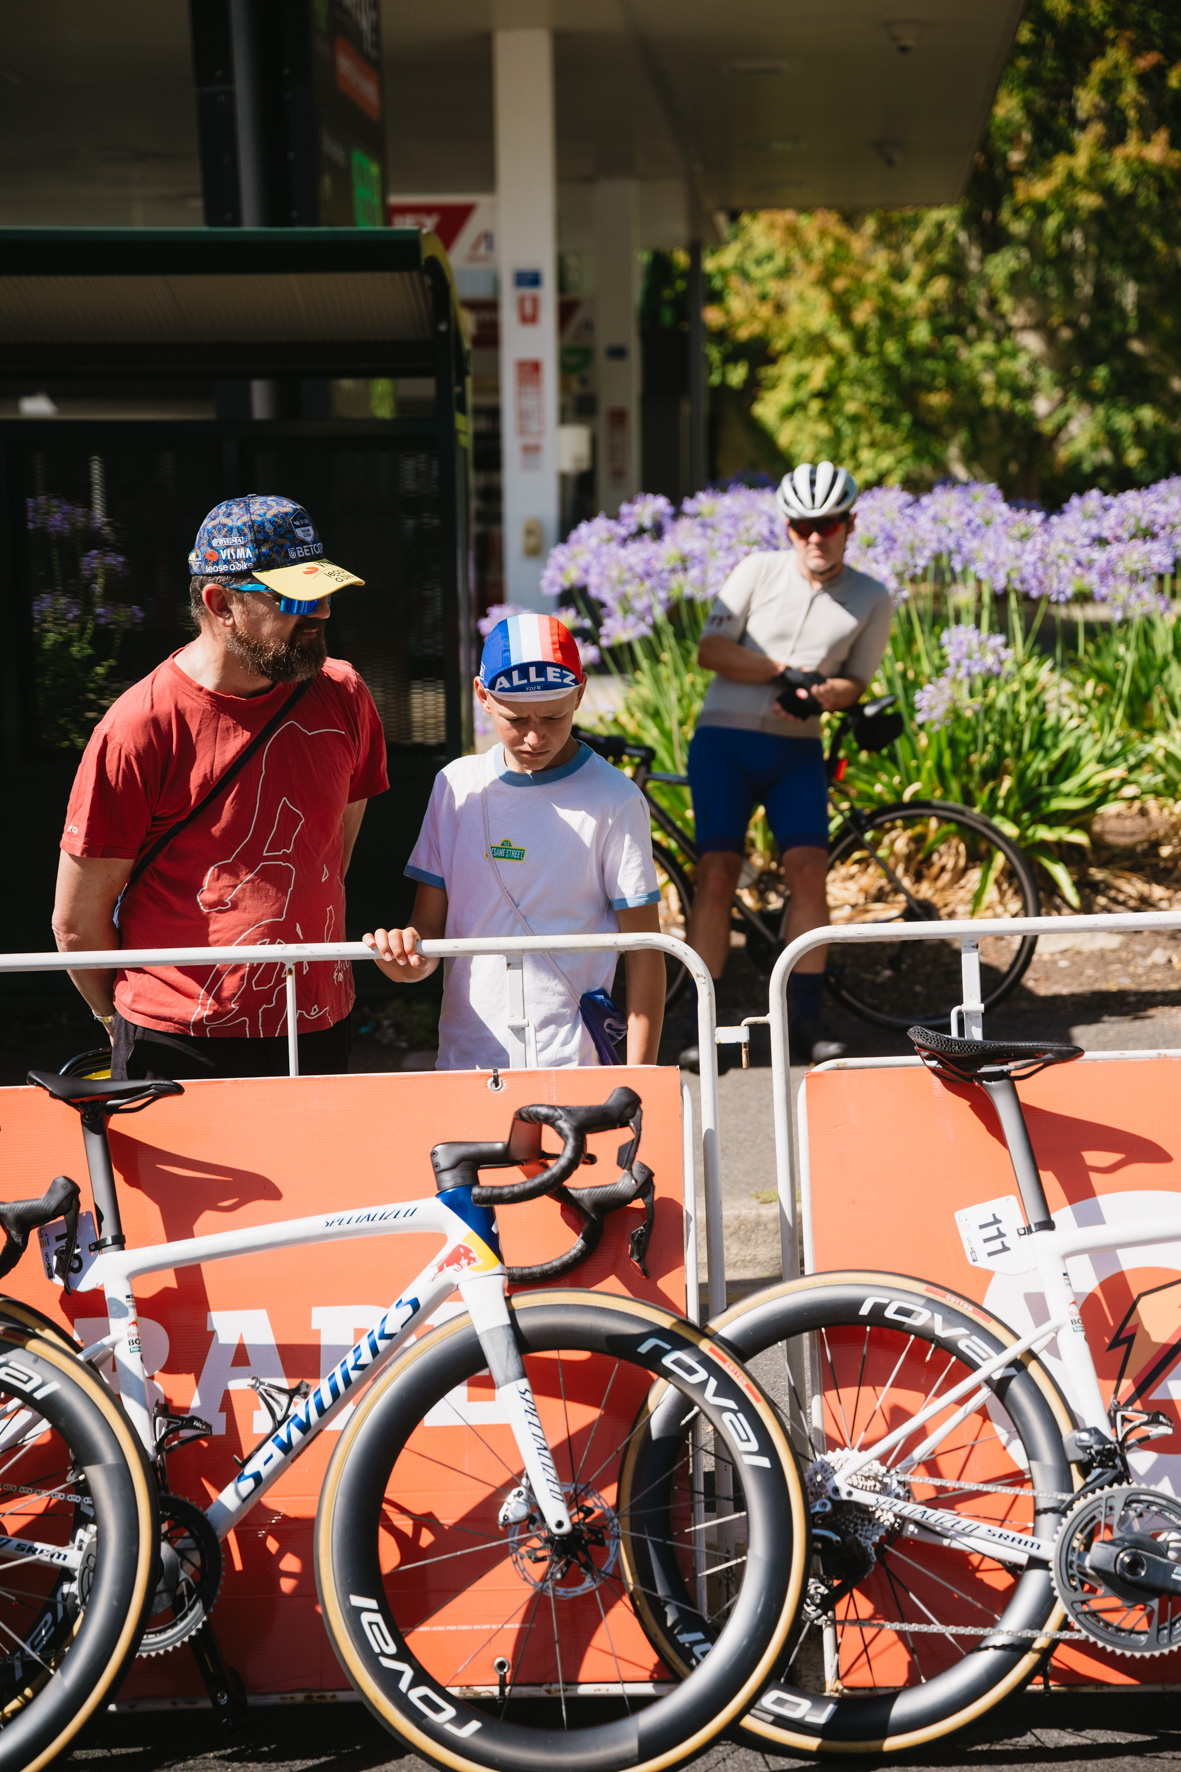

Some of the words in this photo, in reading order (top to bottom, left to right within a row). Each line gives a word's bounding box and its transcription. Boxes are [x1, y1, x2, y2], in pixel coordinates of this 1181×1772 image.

[220, 547, 253, 560] VISMA
[205, 564, 228, 573] lease
[495, 666, 576, 691] ALLEZ
[506, 849, 524, 859] STREET
[322, 1206, 418, 1228] SPECIALIZED
[978, 1213, 1011, 1257] 111
[945, 1294, 974, 1312] COTTON
[0, 1356, 61, 1400] al
[725, 1361, 748, 1386] COTTON
[236, 1297, 421, 1501] S-WORKS
[516, 1384, 565, 1503] SPECIALIZED
[873, 1497, 980, 1534] SPECIALIZED
[985, 1528, 1041, 1551] SRAM
